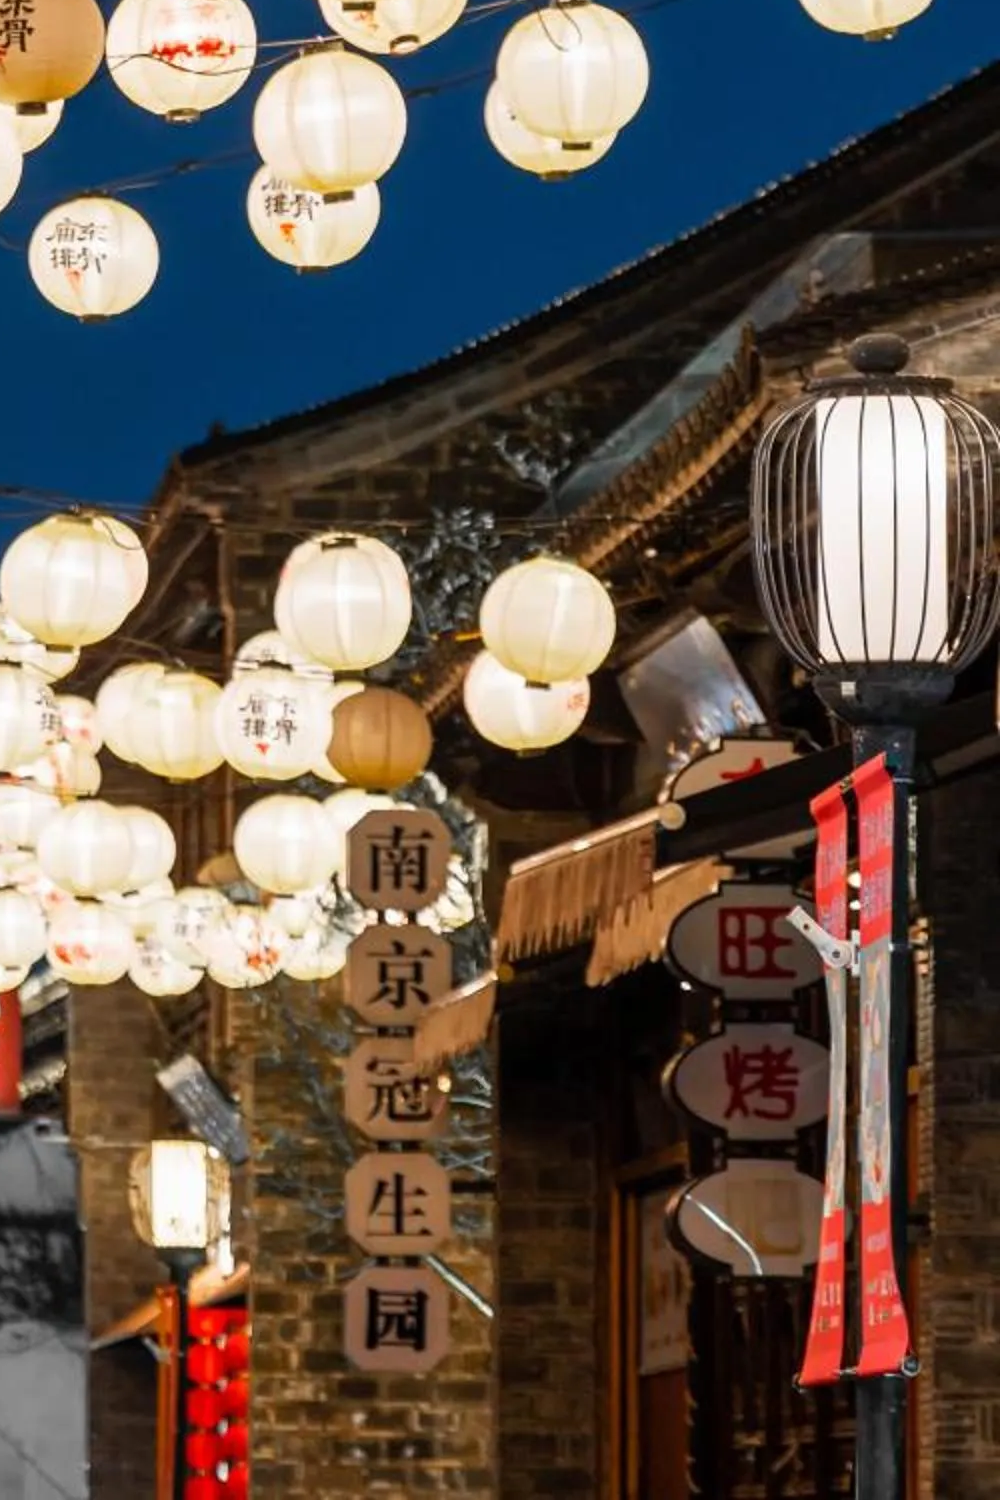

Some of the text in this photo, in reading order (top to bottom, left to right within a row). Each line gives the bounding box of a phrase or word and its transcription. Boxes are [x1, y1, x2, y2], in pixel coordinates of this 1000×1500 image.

[45, 216, 108, 244] 庙东
[364, 824, 435, 1352] 南京冠生园
